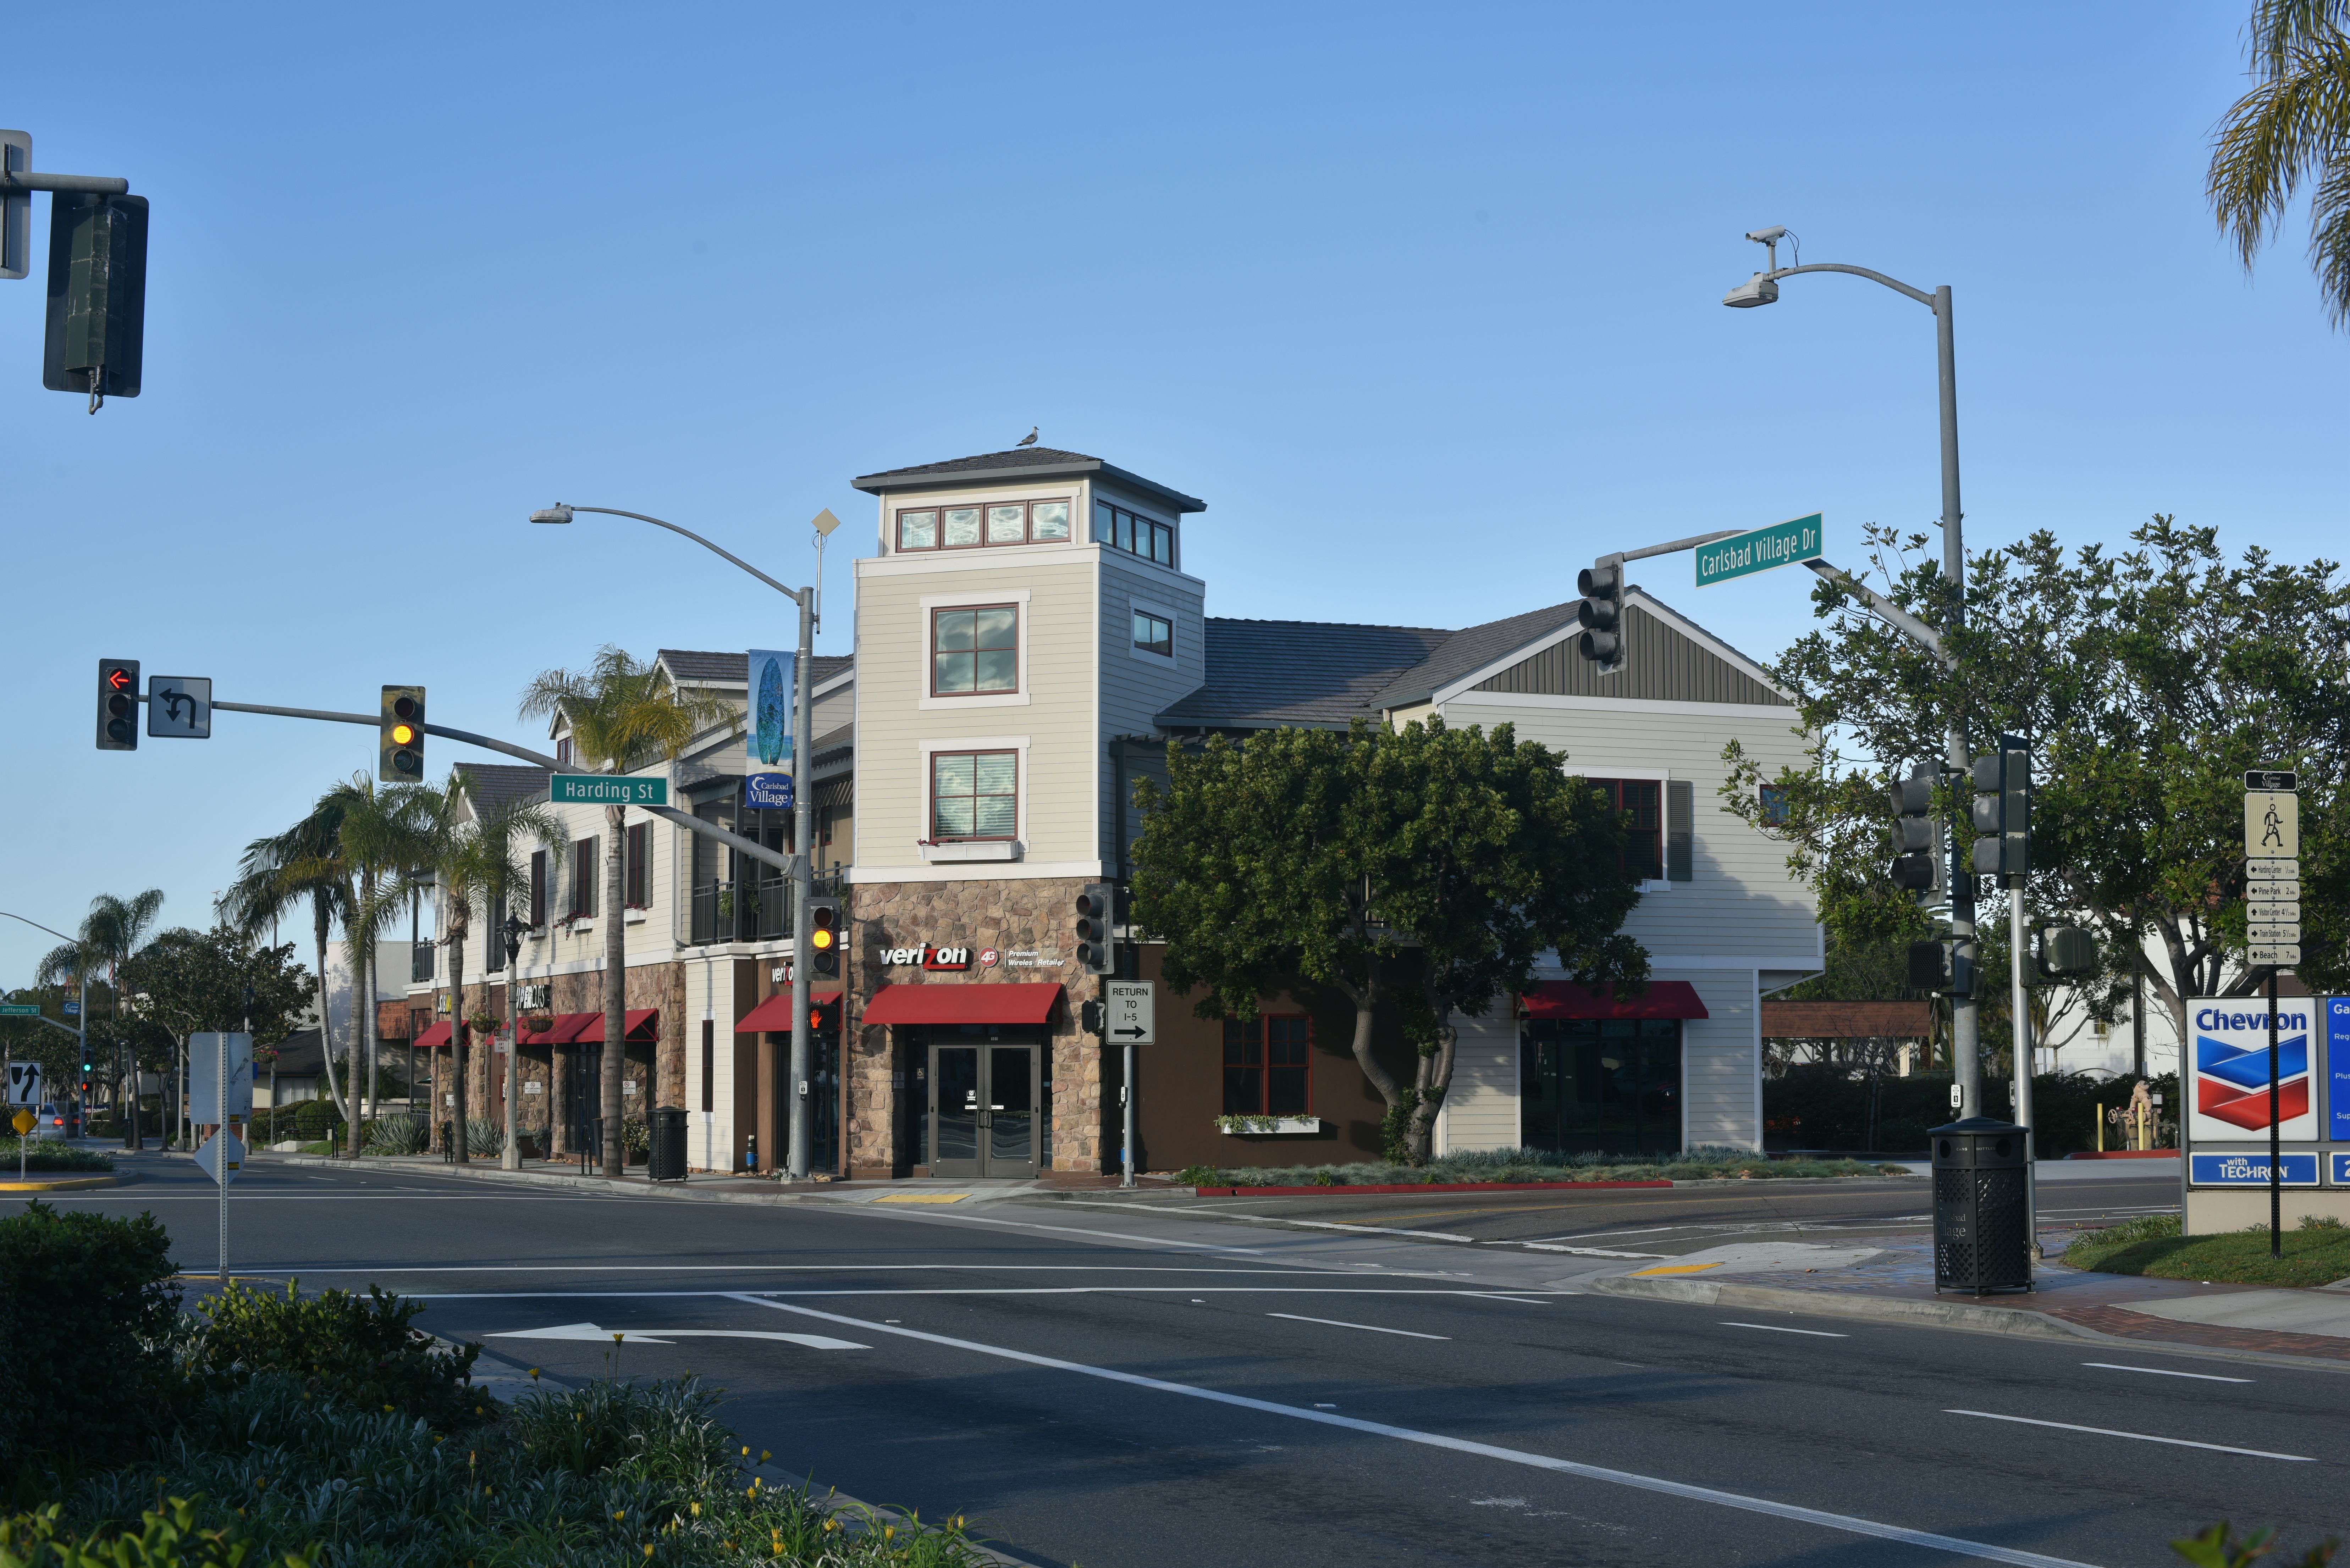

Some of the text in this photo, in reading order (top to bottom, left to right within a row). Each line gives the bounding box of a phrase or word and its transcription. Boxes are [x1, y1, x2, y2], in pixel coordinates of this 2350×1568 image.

[1702, 528, 1816, 577] Carlsbad Village Dr
[2262, 780, 2281, 789] Village
[566, 782, 653, 802] Harding St
[749, 790, 788, 806] Village
[2258, 865, 2271, 875] Harding
[879, 942, 967, 969] verizon
[981, 951, 995, 963] 4G
[2260, 951, 2278, 959] Beach
[772, 961, 793, 986] verizo
[516, 984, 545, 1009] UPERCUTS
[1113, 988, 1148, 996] RETURN
[1125, 1000, 1137, 1008] TO
[1124, 1013, 1137, 1021] I-5
[2196, 1008, 2307, 1031] Chevron
[2227, 1157, 2247, 1166] with
